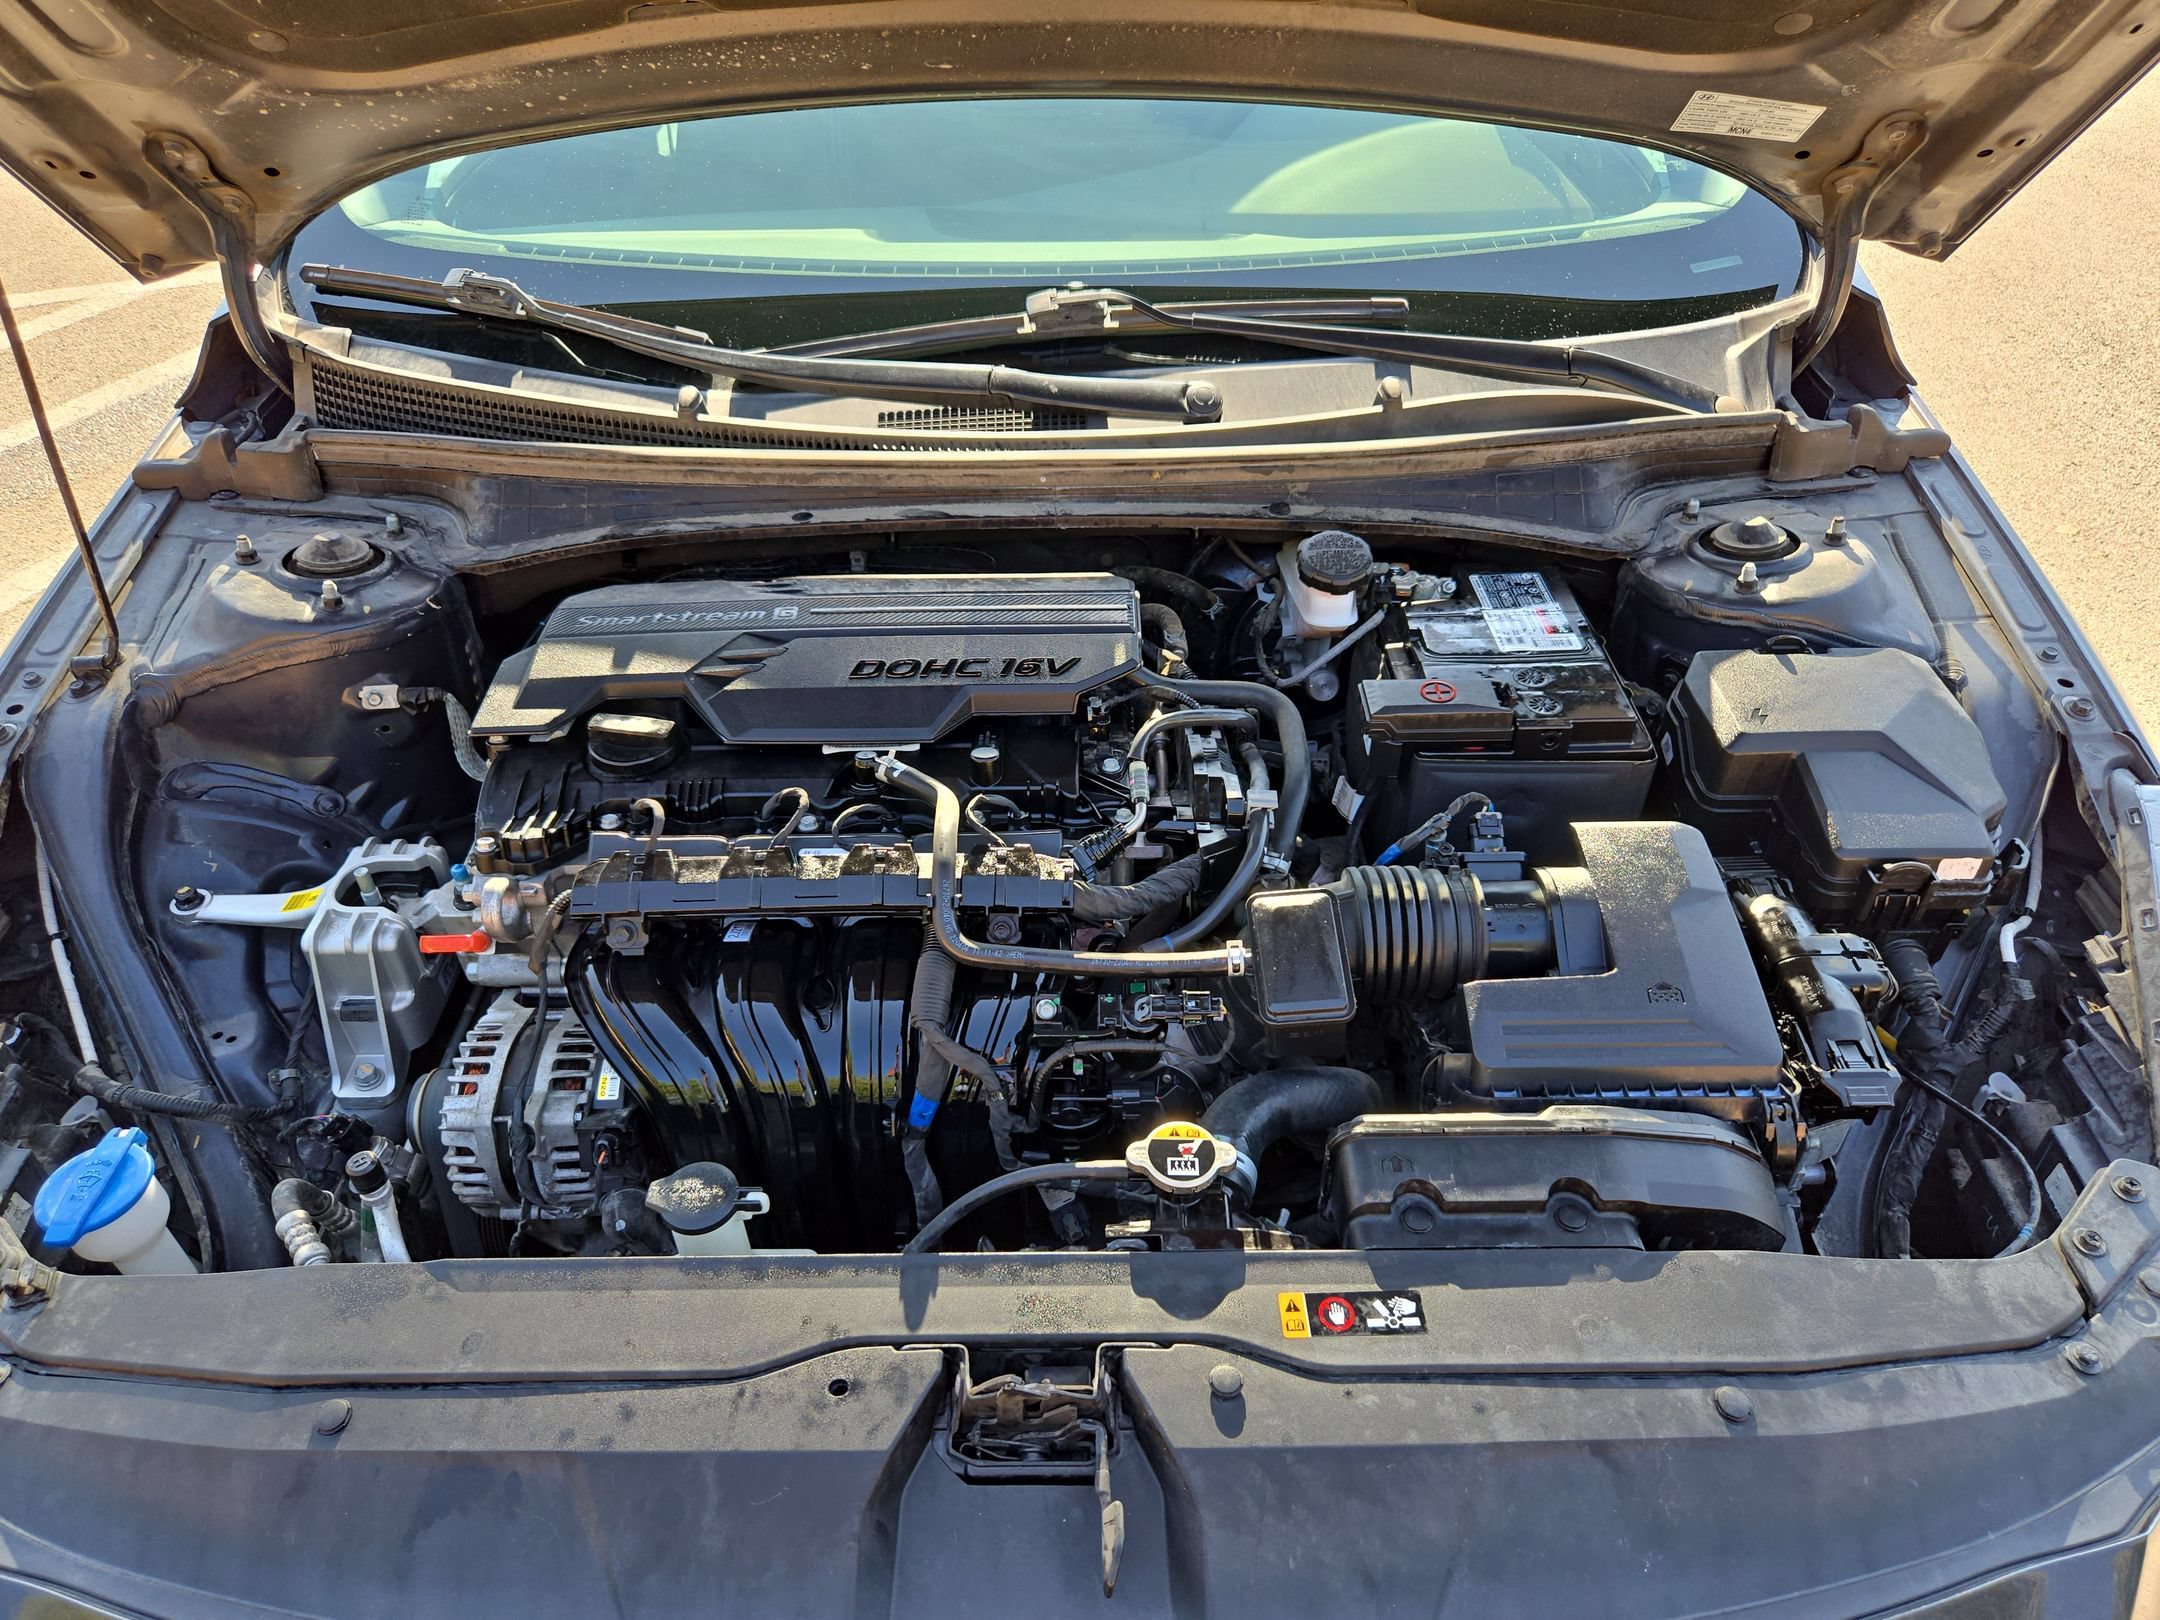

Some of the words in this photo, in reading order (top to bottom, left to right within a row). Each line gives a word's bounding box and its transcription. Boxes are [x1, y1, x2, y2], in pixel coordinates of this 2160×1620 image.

[576, 609, 766, 626] Smartstream
[849, 657, 990, 679] DOHC
[1000, 657, 1081, 677] 16V
